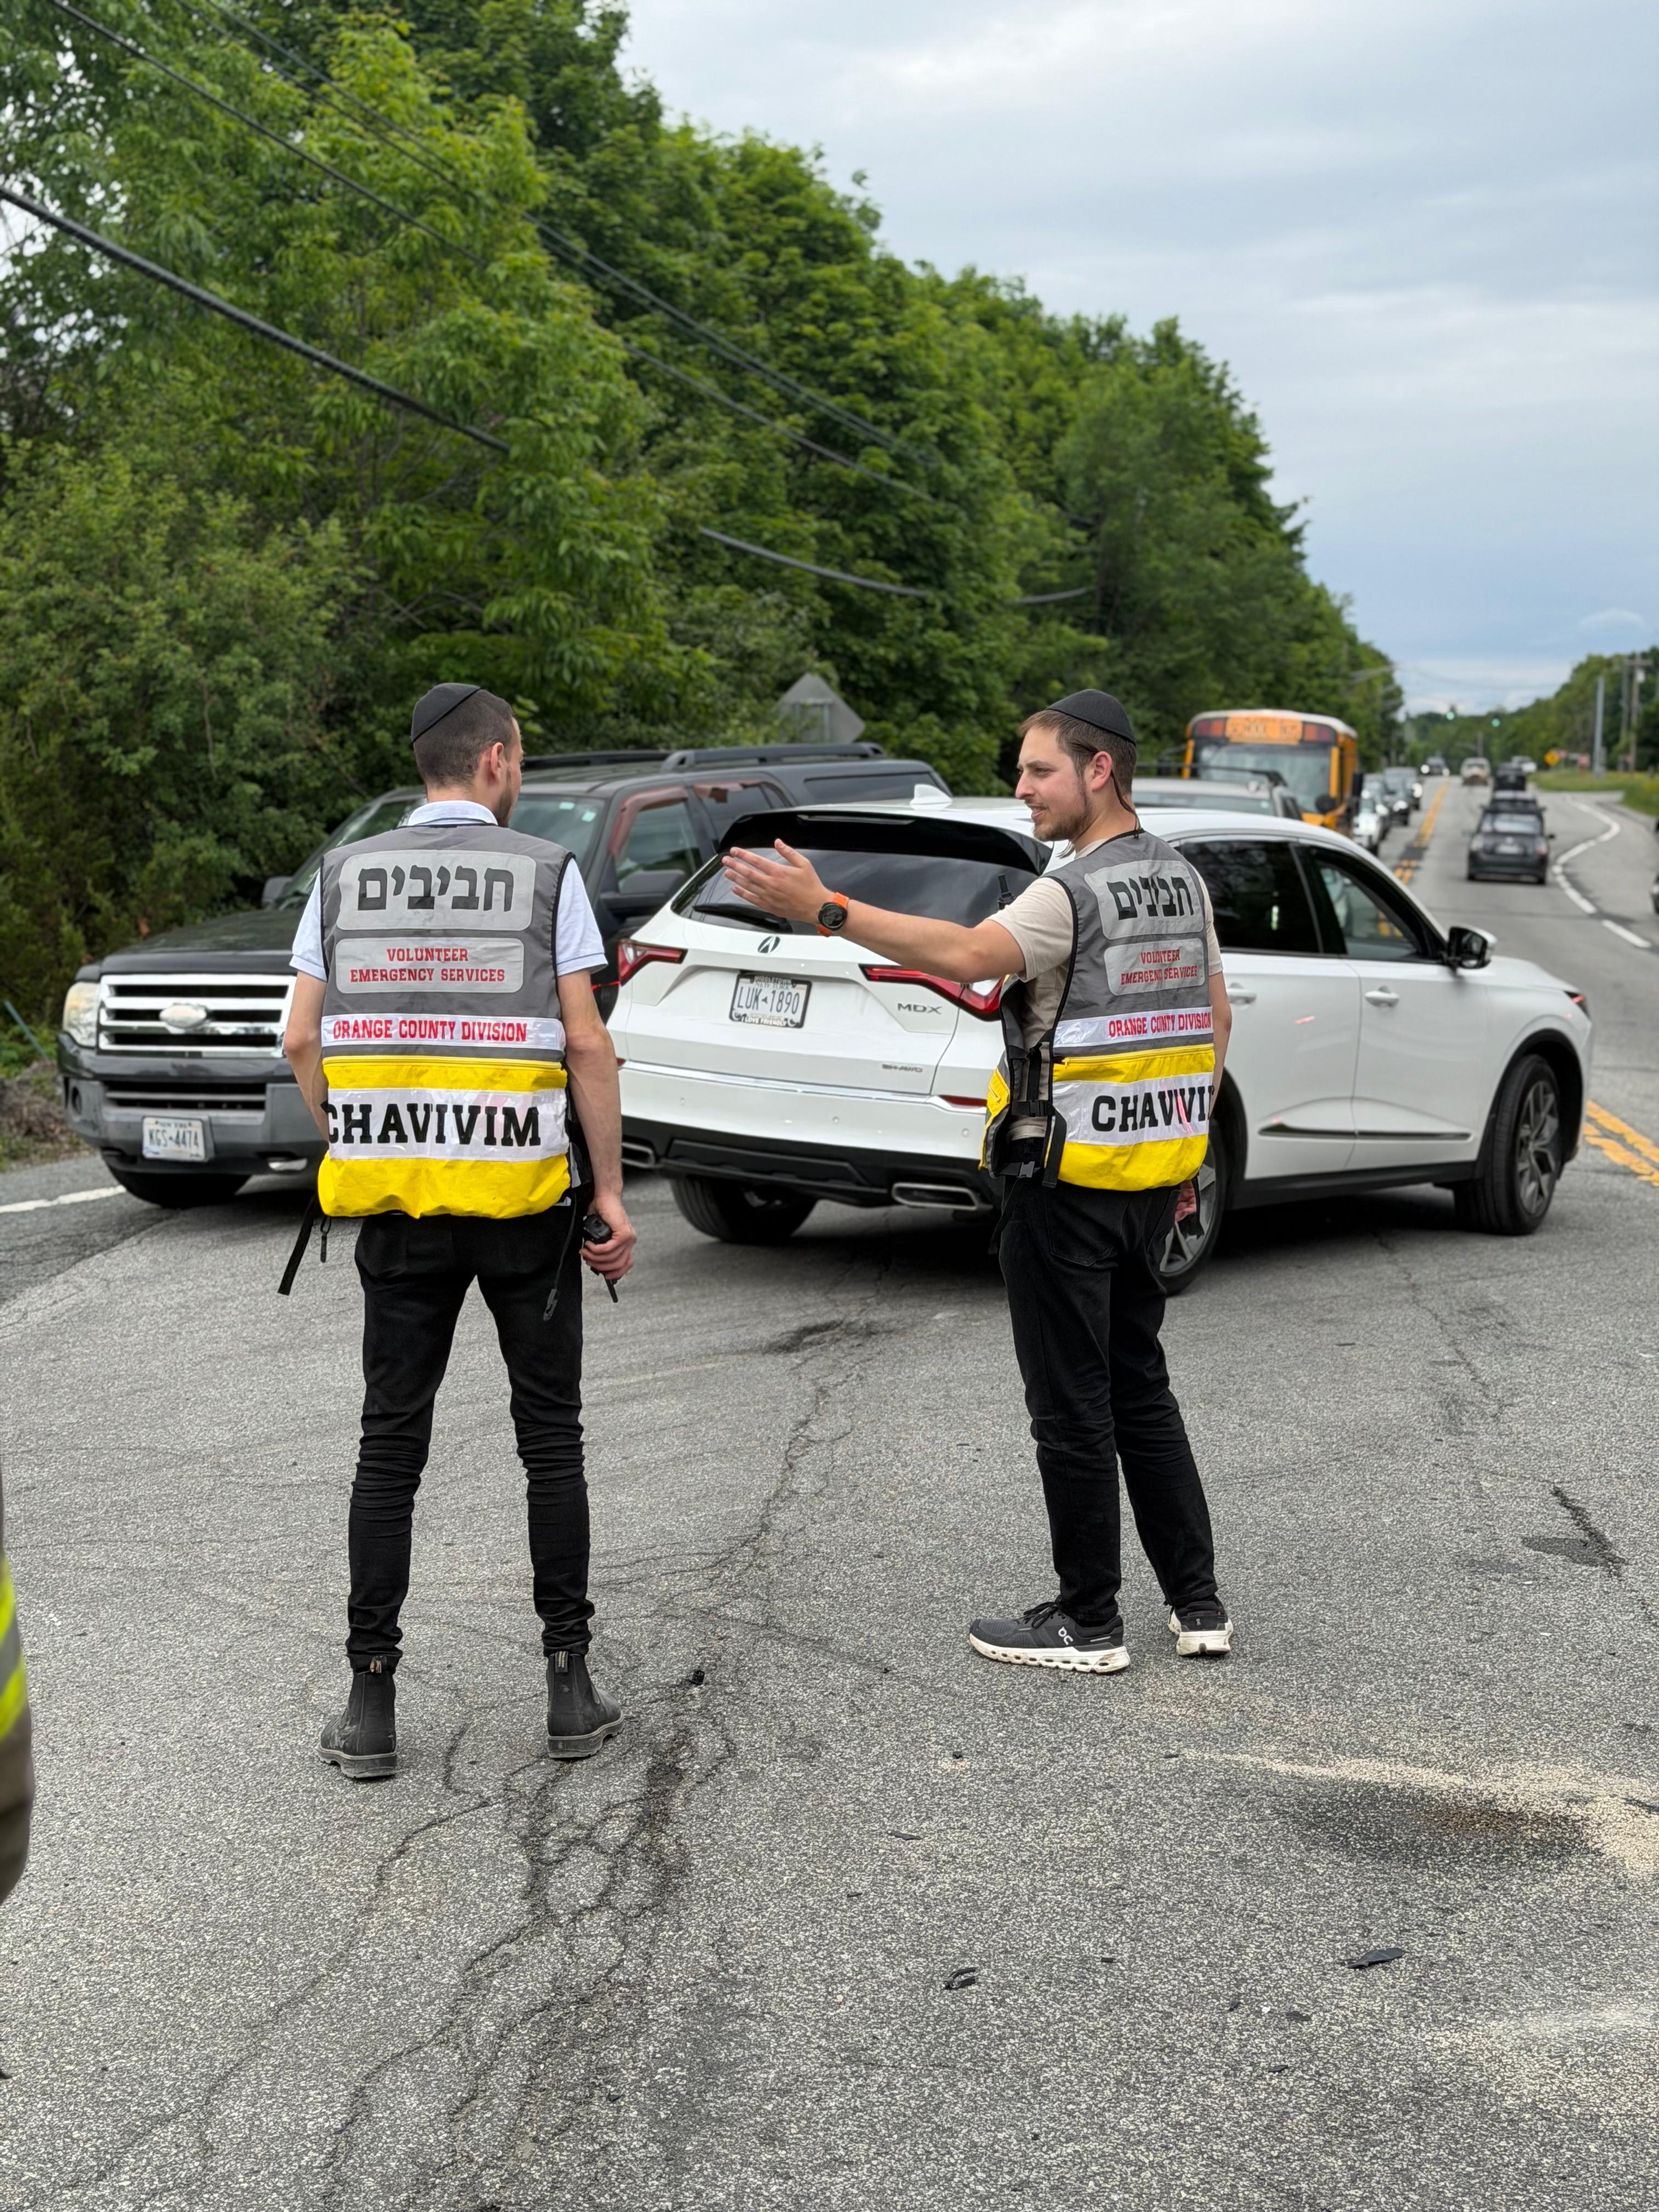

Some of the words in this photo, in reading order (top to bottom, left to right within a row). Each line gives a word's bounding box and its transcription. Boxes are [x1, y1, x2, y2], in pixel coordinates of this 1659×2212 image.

[358, 865, 514, 912] חביבים
[386, 948, 469, 962] VOLUNTEER
[350, 968, 435, 983] EMERGENCY
[441, 968, 505, 982] SERVICES
[754, 975, 792, 984] MIDDLETOWN
[898, 1003, 943, 1014] MDX
[333, 1019, 393, 1039] ORANGE
[398, 1019, 456, 1039] COUNTY
[461, 1021, 527, 1042] DIVISION
[1109, 1017, 1148, 1037] ORANGE
